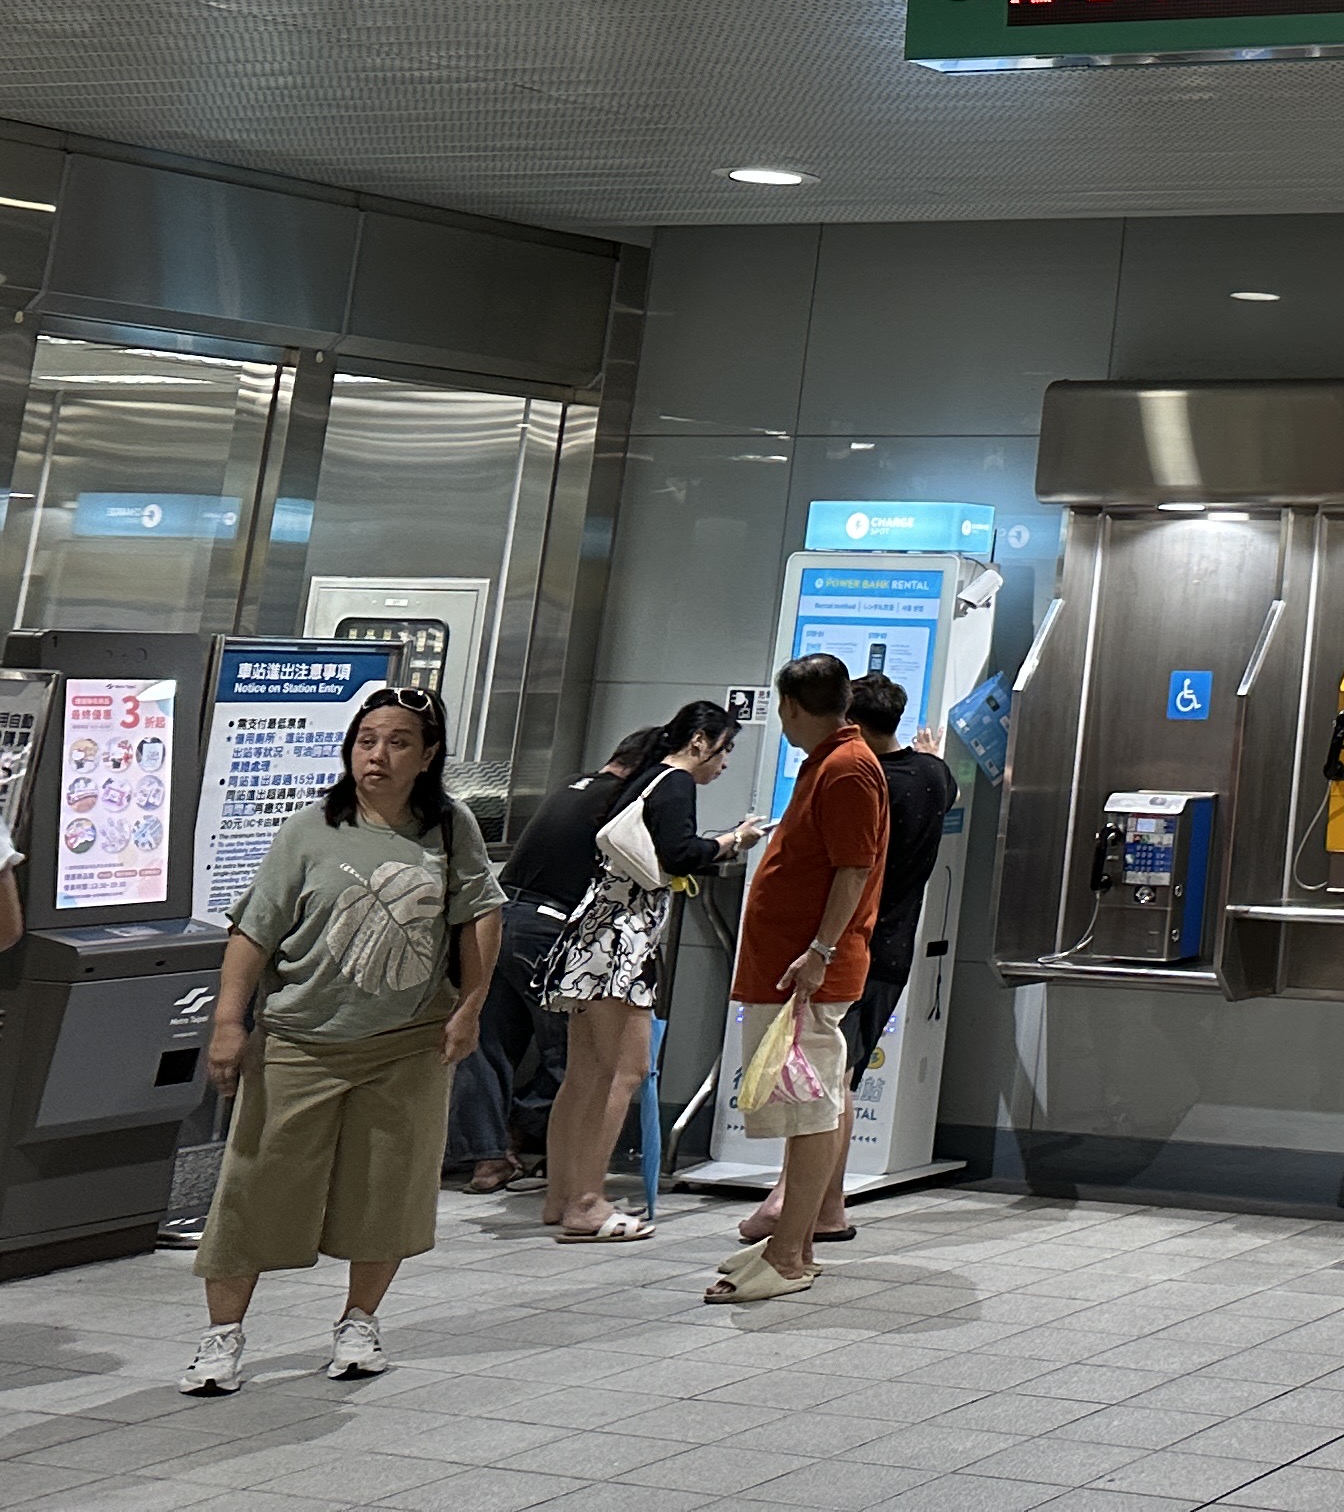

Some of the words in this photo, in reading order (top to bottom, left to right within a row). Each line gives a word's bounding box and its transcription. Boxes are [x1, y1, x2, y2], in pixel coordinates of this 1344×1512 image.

[871, 517, 915, 528] CHARGE
[826, 577, 860, 588] POWER
[861, 578, 890, 589] BANK
[891, 579, 930, 590] RENTAL
[237, 662, 352, 681] 車站進出注意事項
[234, 682, 266, 694] Notice
[268, 683, 280, 694] on
[282, 683, 317, 694] Station
[318, 683, 344, 696] Entry
[120, 695, 140, 729] 3
